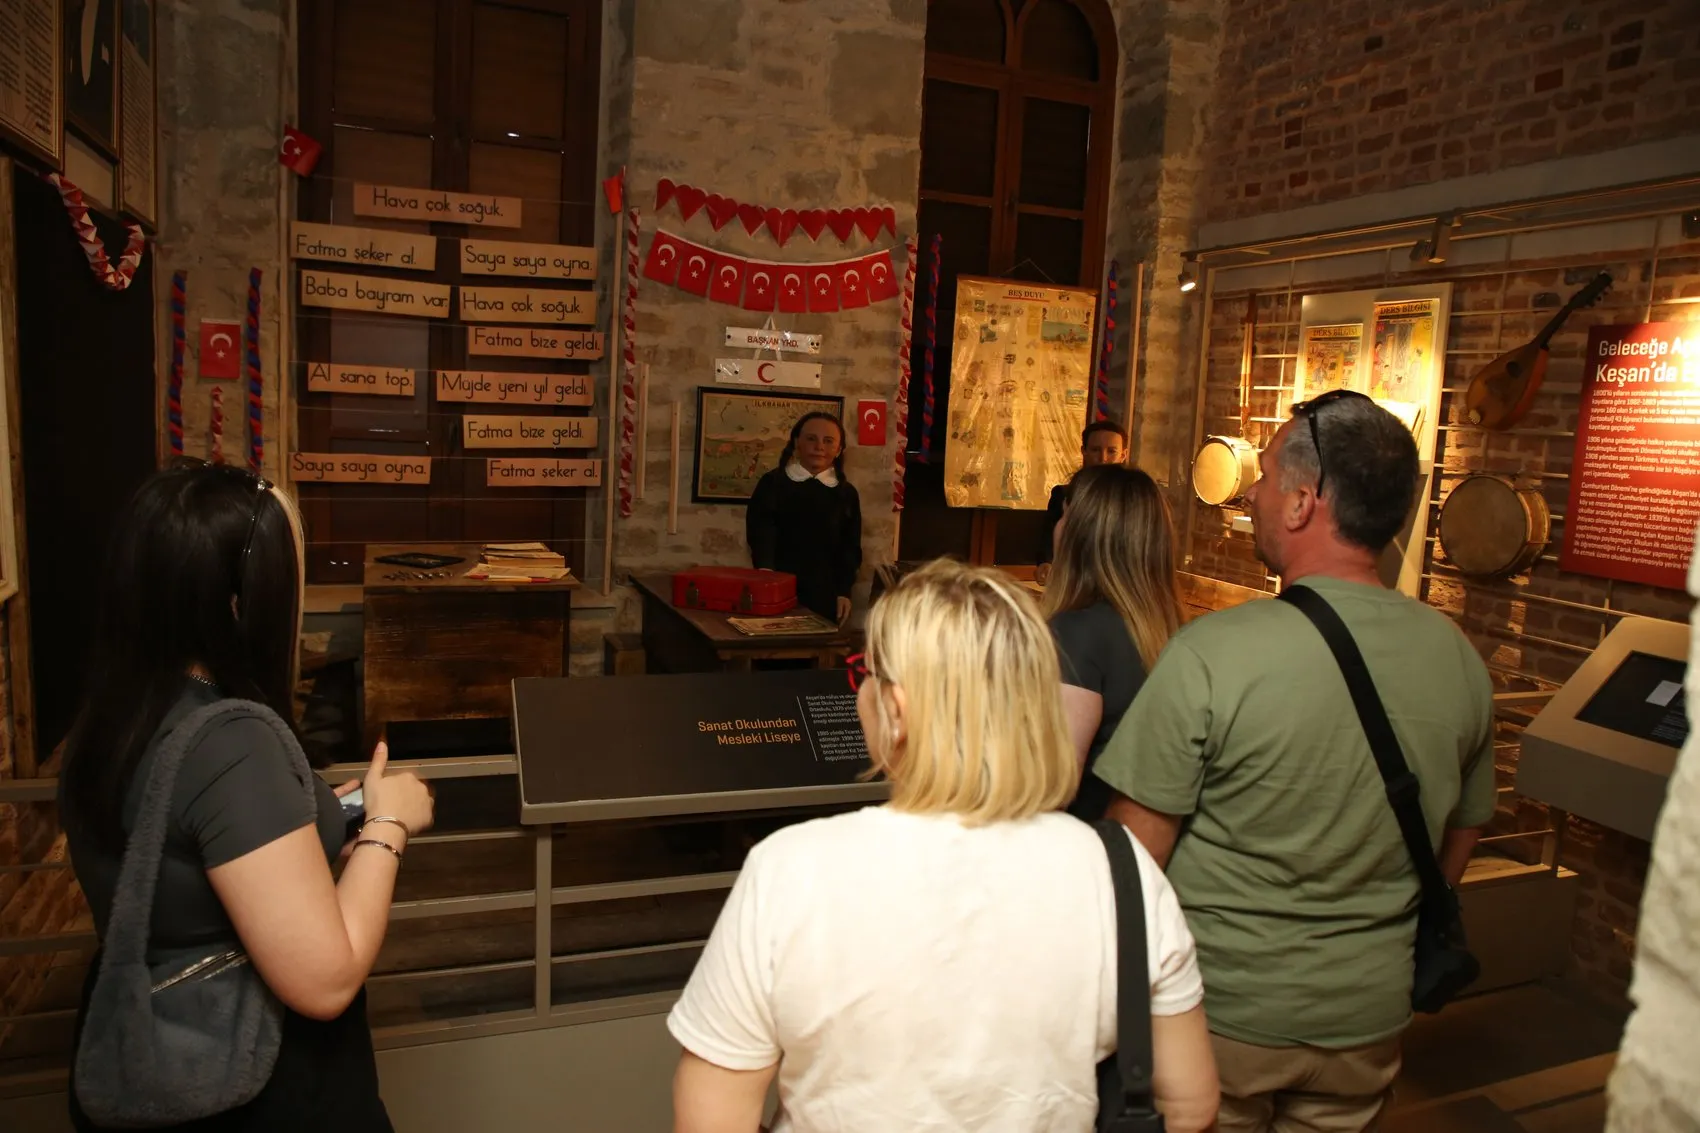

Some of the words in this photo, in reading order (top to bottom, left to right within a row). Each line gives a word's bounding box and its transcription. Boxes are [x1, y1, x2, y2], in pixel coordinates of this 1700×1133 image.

[373, 187, 418, 210] Hava
[426, 193, 451, 212] çok
[459, 198, 504, 223] soğuk.
[296, 234, 347, 258] Fatma
[354, 242, 392, 262] şeker
[401, 246, 417, 265] al.
[465, 245, 506, 272] Saya
[513, 256, 546, 275] saya
[553, 258, 593, 277] oyna.
[306, 276, 348, 298] Baba
[355, 280, 414, 310] bayram
[422, 295, 449, 308] var.
[463, 292, 504, 311] Hava
[511, 294, 533, 312] çok
[541, 296, 584, 321] soğuk.
[474, 327, 523, 347] Fatma
[530, 330, 558, 349] bize
[564, 333, 601, 357] geldi.
[747, 335, 779, 346] BAŞKAN
[1599, 337, 1669, 359] Geleceğe
[310, 363, 331, 382] Al
[340, 373, 376, 384] sana
[386, 371, 413, 394] top.
[442, 373, 491, 399] Müjde
[498, 382, 527, 400] yeni
[534, 376, 548, 401] yıl
[555, 378, 589, 403] geldi.
[1596, 361, 1678, 387] Keşan'da
[468, 421, 512, 439] Fatma
[520, 421, 545, 439] bize
[552, 421, 584, 445] geldi.
[293, 453, 334, 480] Saya
[341, 463, 377, 480] saya
[384, 464, 427, 481] oyna.
[490, 460, 535, 478] Fatma
[542, 461, 577, 479] şeker
[584, 461, 598, 478] al.
[698, 720, 733, 732] Sanat
[735, 717, 797, 730] Okulundan
[717, 733, 763, 745] Mesleki
[766, 732, 801, 744] Liseye
